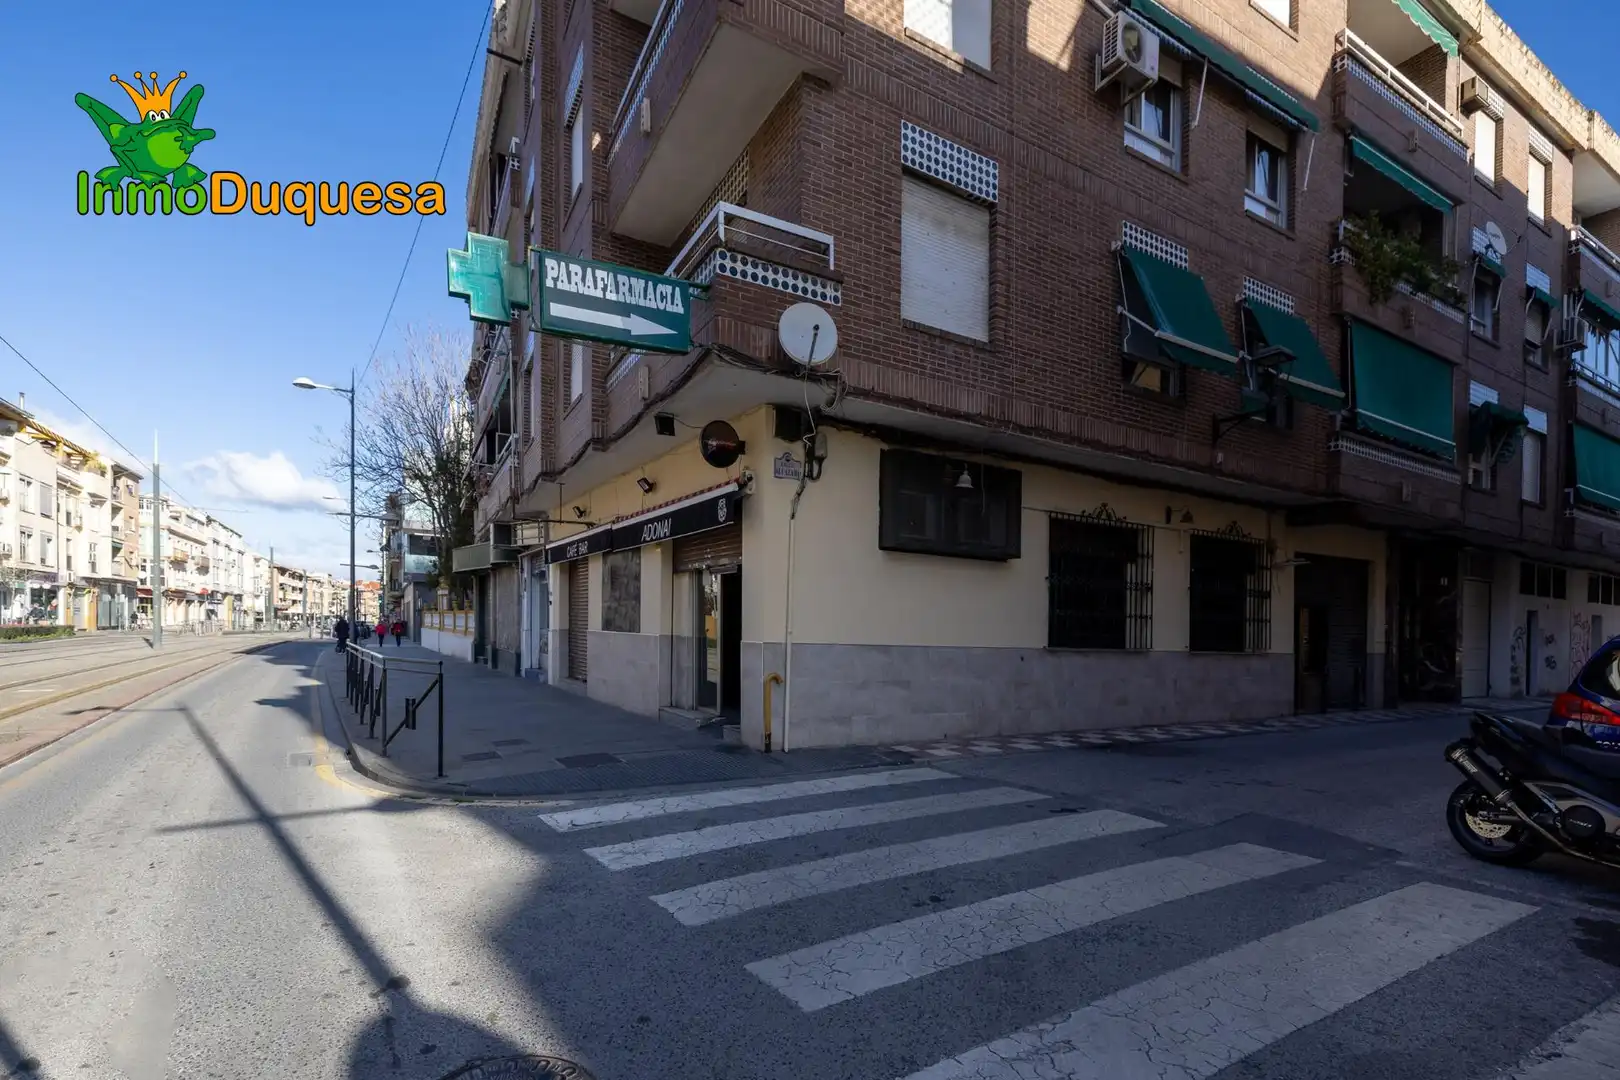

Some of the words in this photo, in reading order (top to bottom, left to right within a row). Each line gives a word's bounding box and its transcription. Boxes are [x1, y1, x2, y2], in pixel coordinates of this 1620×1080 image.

[544, 257, 685, 315] PARAFARMACIA
[641, 518, 672, 542] ADONAI
[566, 543, 578, 558] CAFÉ
[578, 540, 589, 555] BAR
